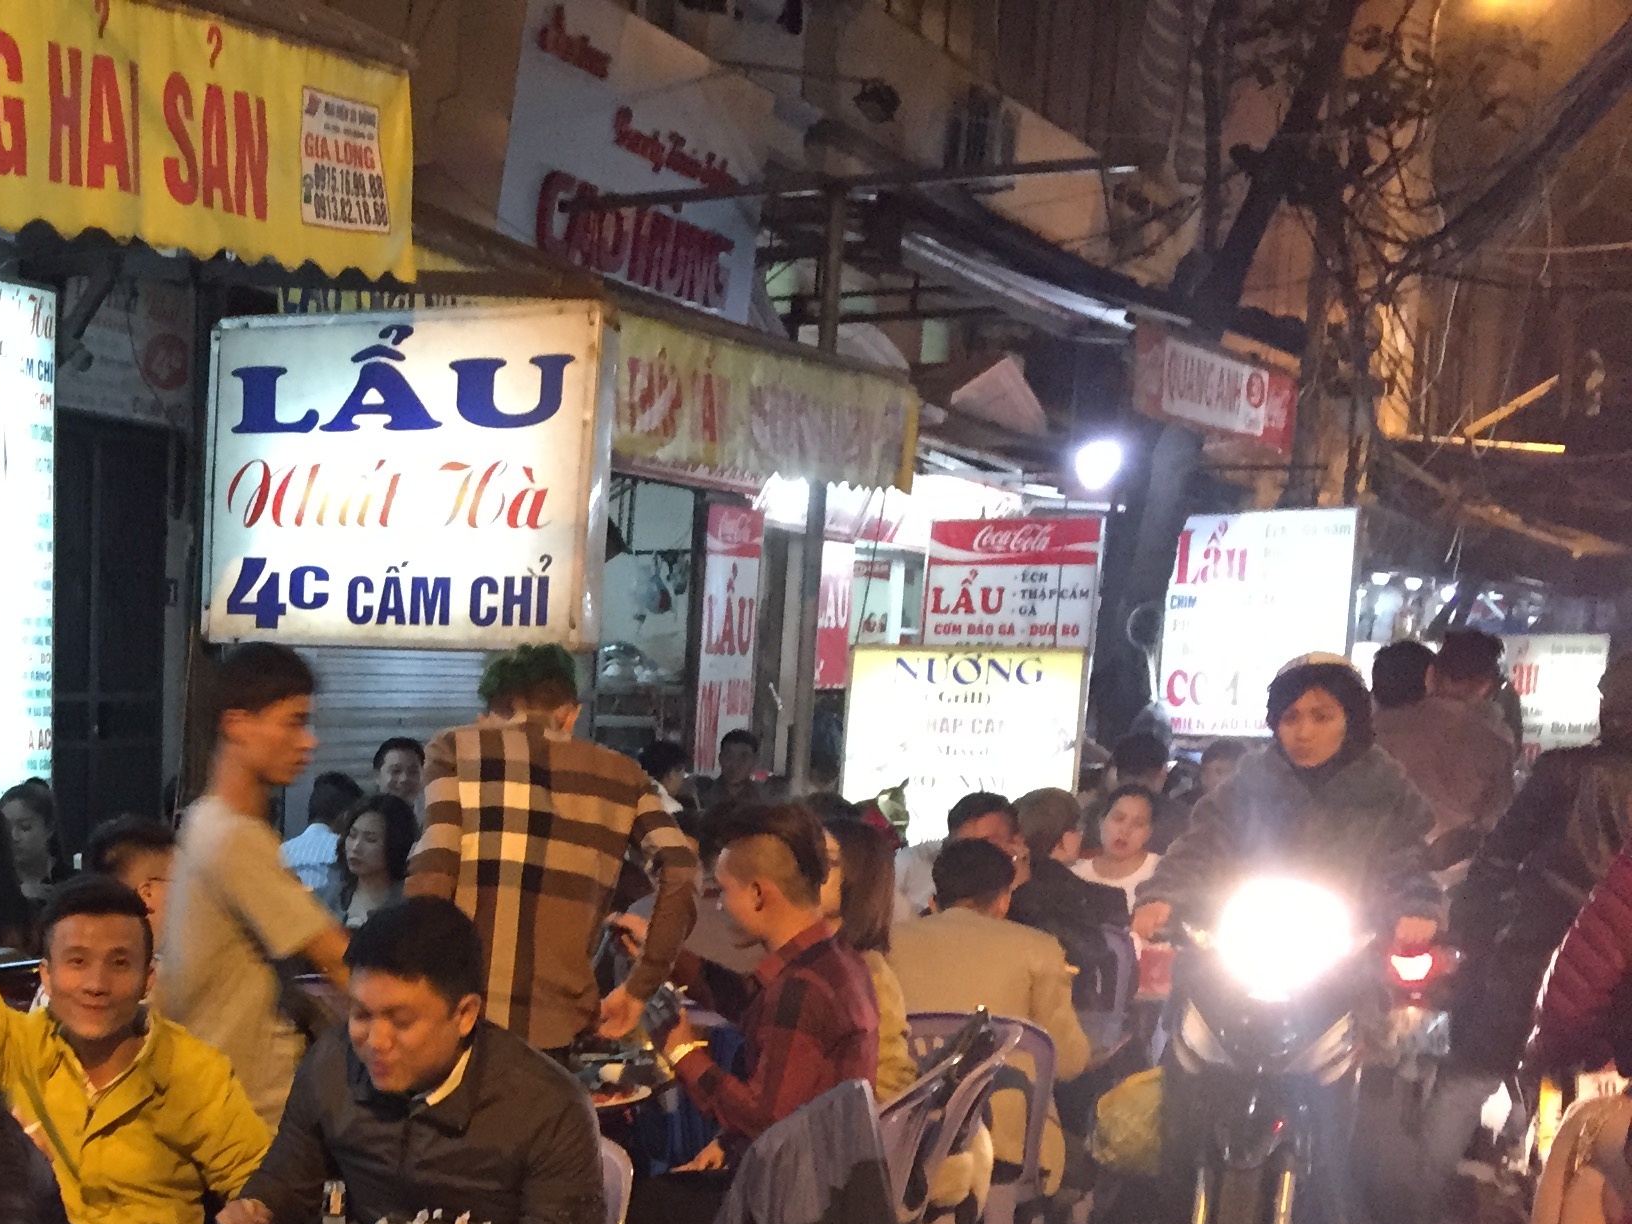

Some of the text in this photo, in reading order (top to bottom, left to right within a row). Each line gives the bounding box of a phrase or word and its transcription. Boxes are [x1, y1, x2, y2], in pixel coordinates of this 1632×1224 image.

[162, 25, 268, 222] SẢN
[304, 132, 331, 161] GIA
[335, 138, 376, 171] LONG
[230, 323, 576, 434] LẨU
[438, 458, 553, 530] Hà
[226, 554, 553, 630] 4C CẤM CHỈ
[930, 569, 1005, 615] LẨU
